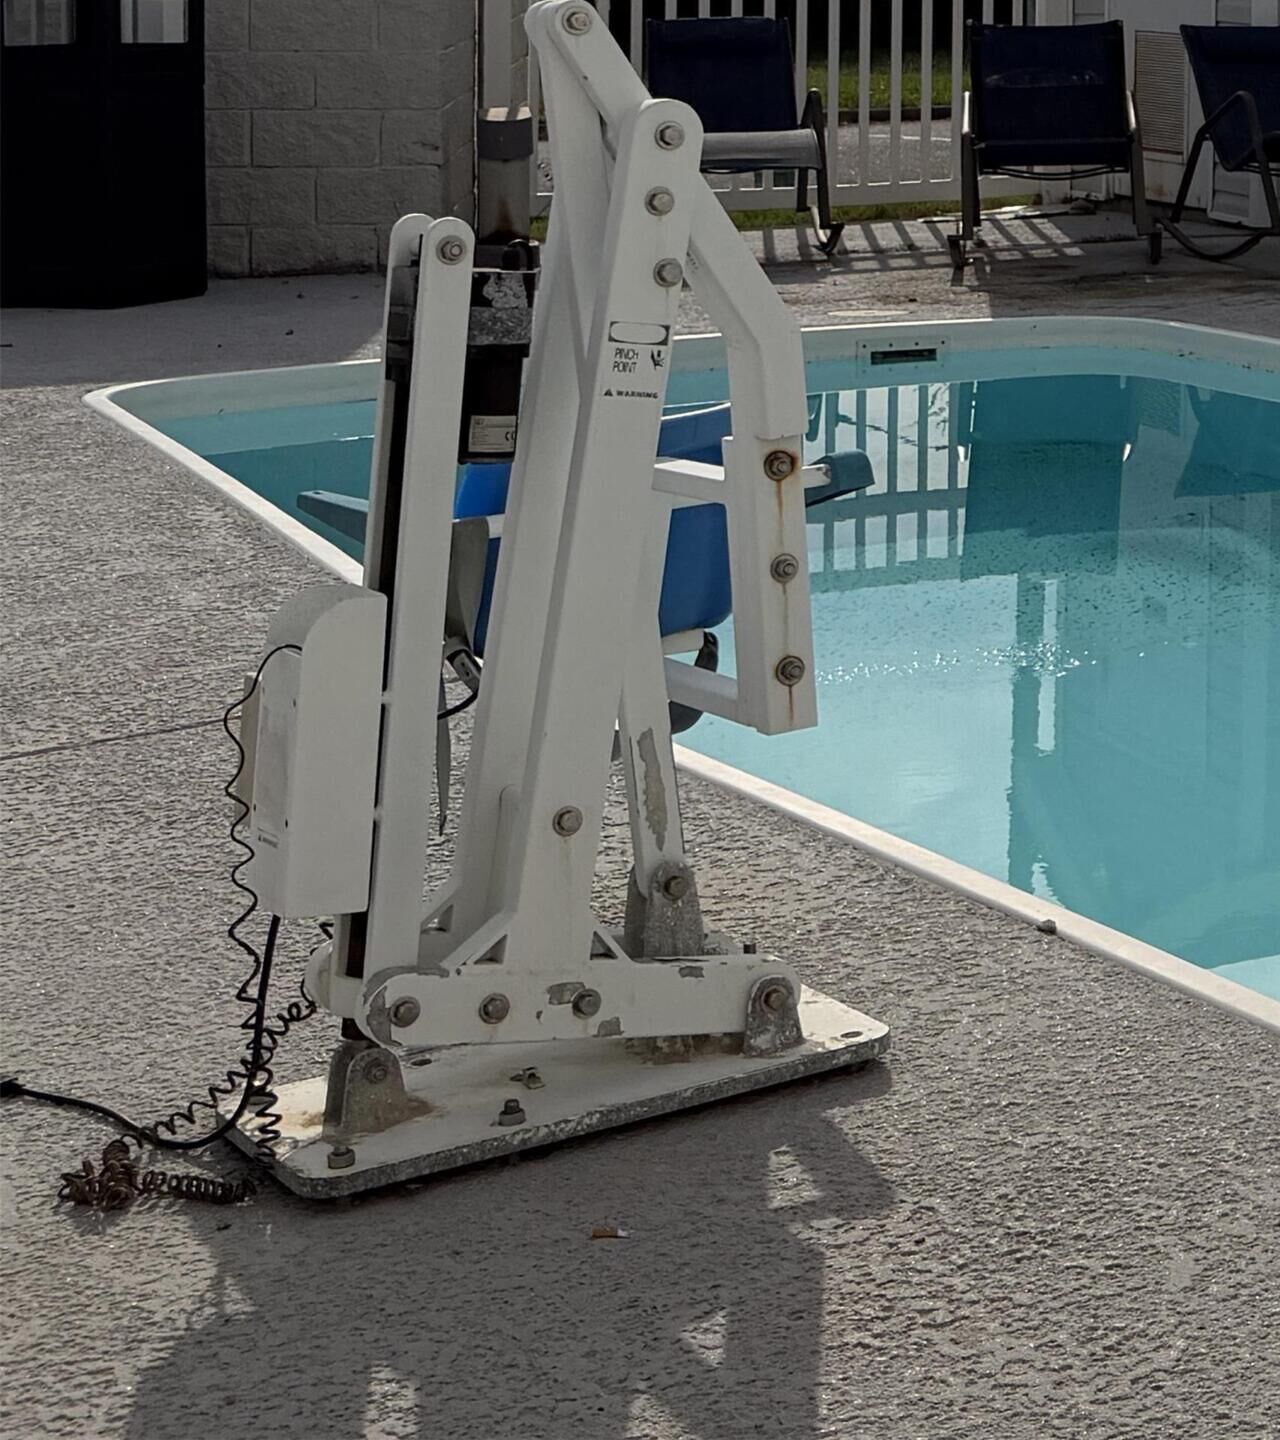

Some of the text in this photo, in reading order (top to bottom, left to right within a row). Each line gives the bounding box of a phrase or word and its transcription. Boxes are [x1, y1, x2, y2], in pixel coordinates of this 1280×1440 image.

[615, 348, 639, 360] PINCH
[612, 361, 637, 373] POINT
[616, 390, 659, 399] WARNING
